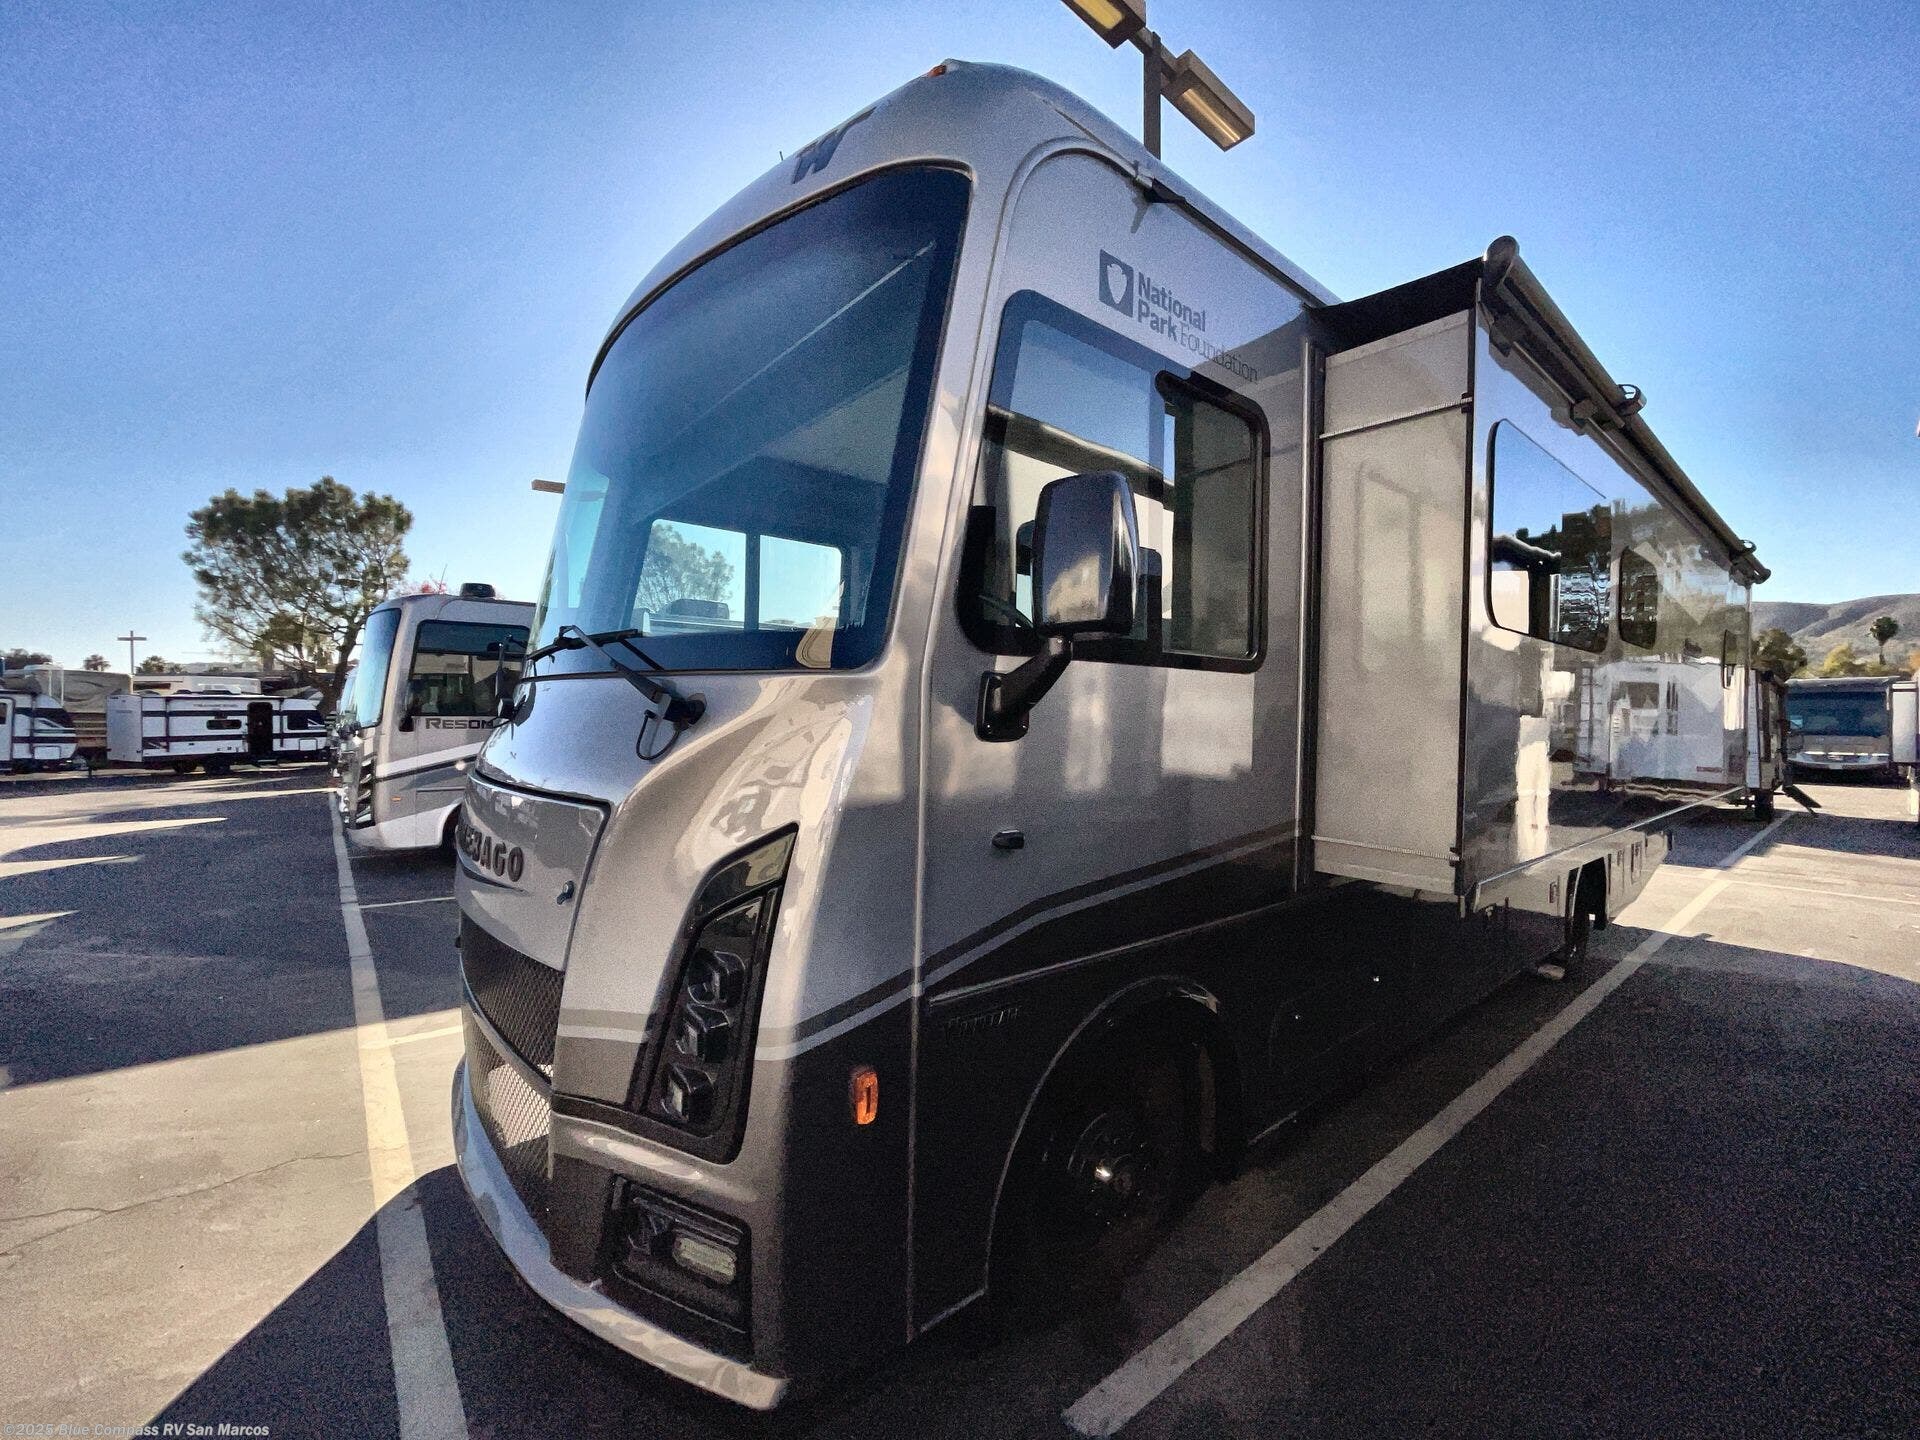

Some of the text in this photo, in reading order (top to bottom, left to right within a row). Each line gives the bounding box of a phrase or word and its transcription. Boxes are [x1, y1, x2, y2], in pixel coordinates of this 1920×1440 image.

[1138, 271, 1206, 333] National
[1137, 298, 1259, 385] Park Foundation
